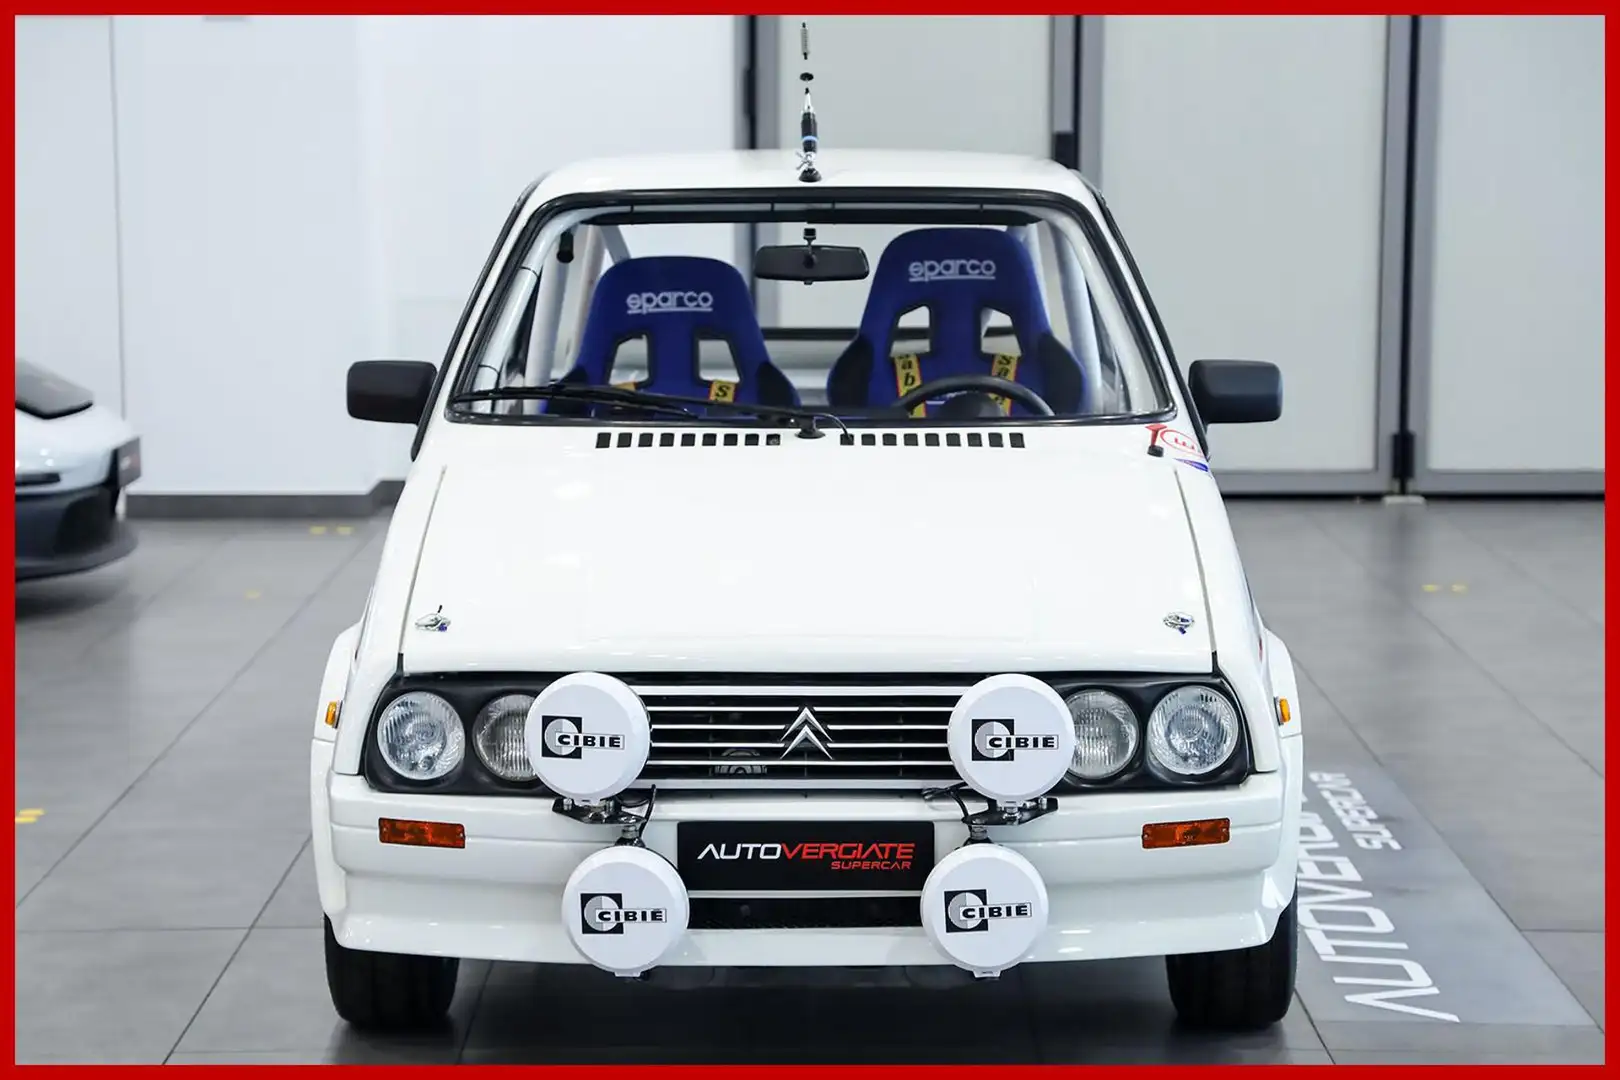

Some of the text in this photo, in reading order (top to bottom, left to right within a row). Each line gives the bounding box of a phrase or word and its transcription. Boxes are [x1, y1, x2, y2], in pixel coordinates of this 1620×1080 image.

[1308, 772, 1402, 850] SUPERCAR
[697, 843, 915, 860] AUTOVERGIATE
[831, 861, 912, 870] SUPERCAR
